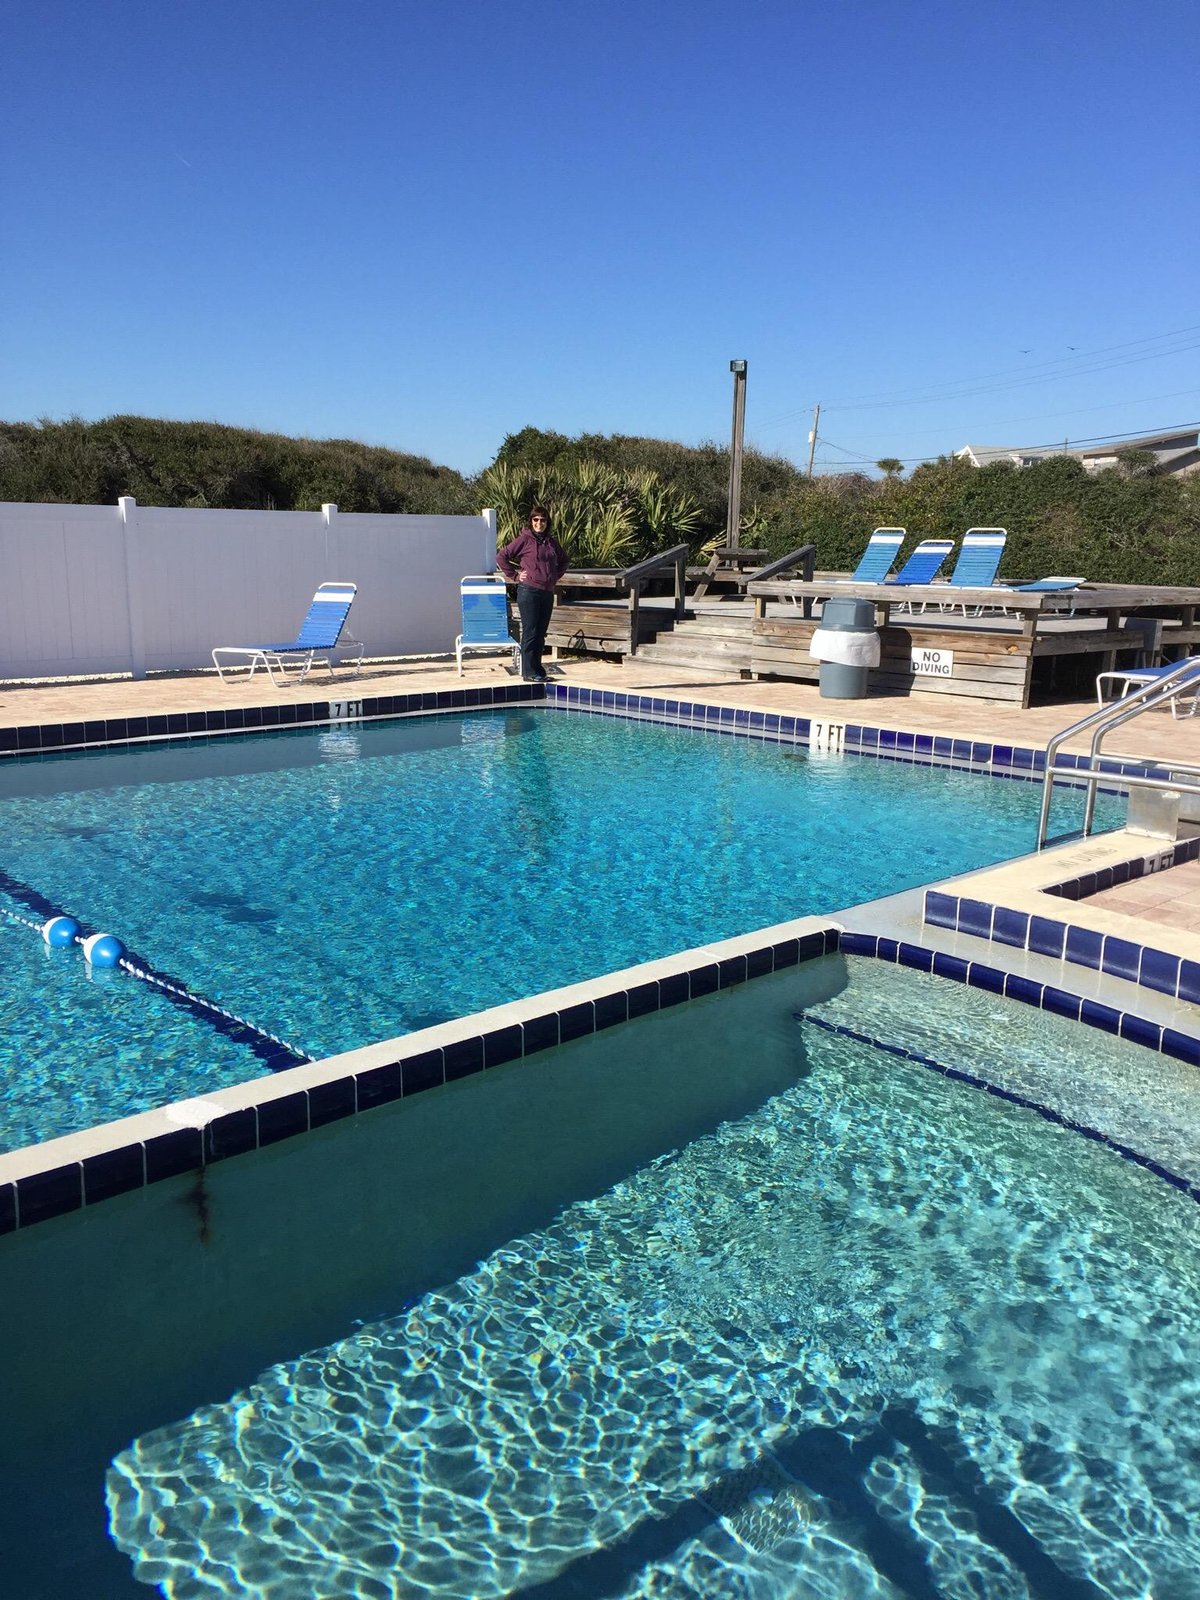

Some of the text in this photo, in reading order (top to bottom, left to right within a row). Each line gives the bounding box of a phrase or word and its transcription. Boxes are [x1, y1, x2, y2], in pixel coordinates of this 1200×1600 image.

[923, 651, 941, 663] NO
[912, 662, 950, 675] DIVING
[335, 703, 341, 717] 7
[816, 723, 822, 737] 7
